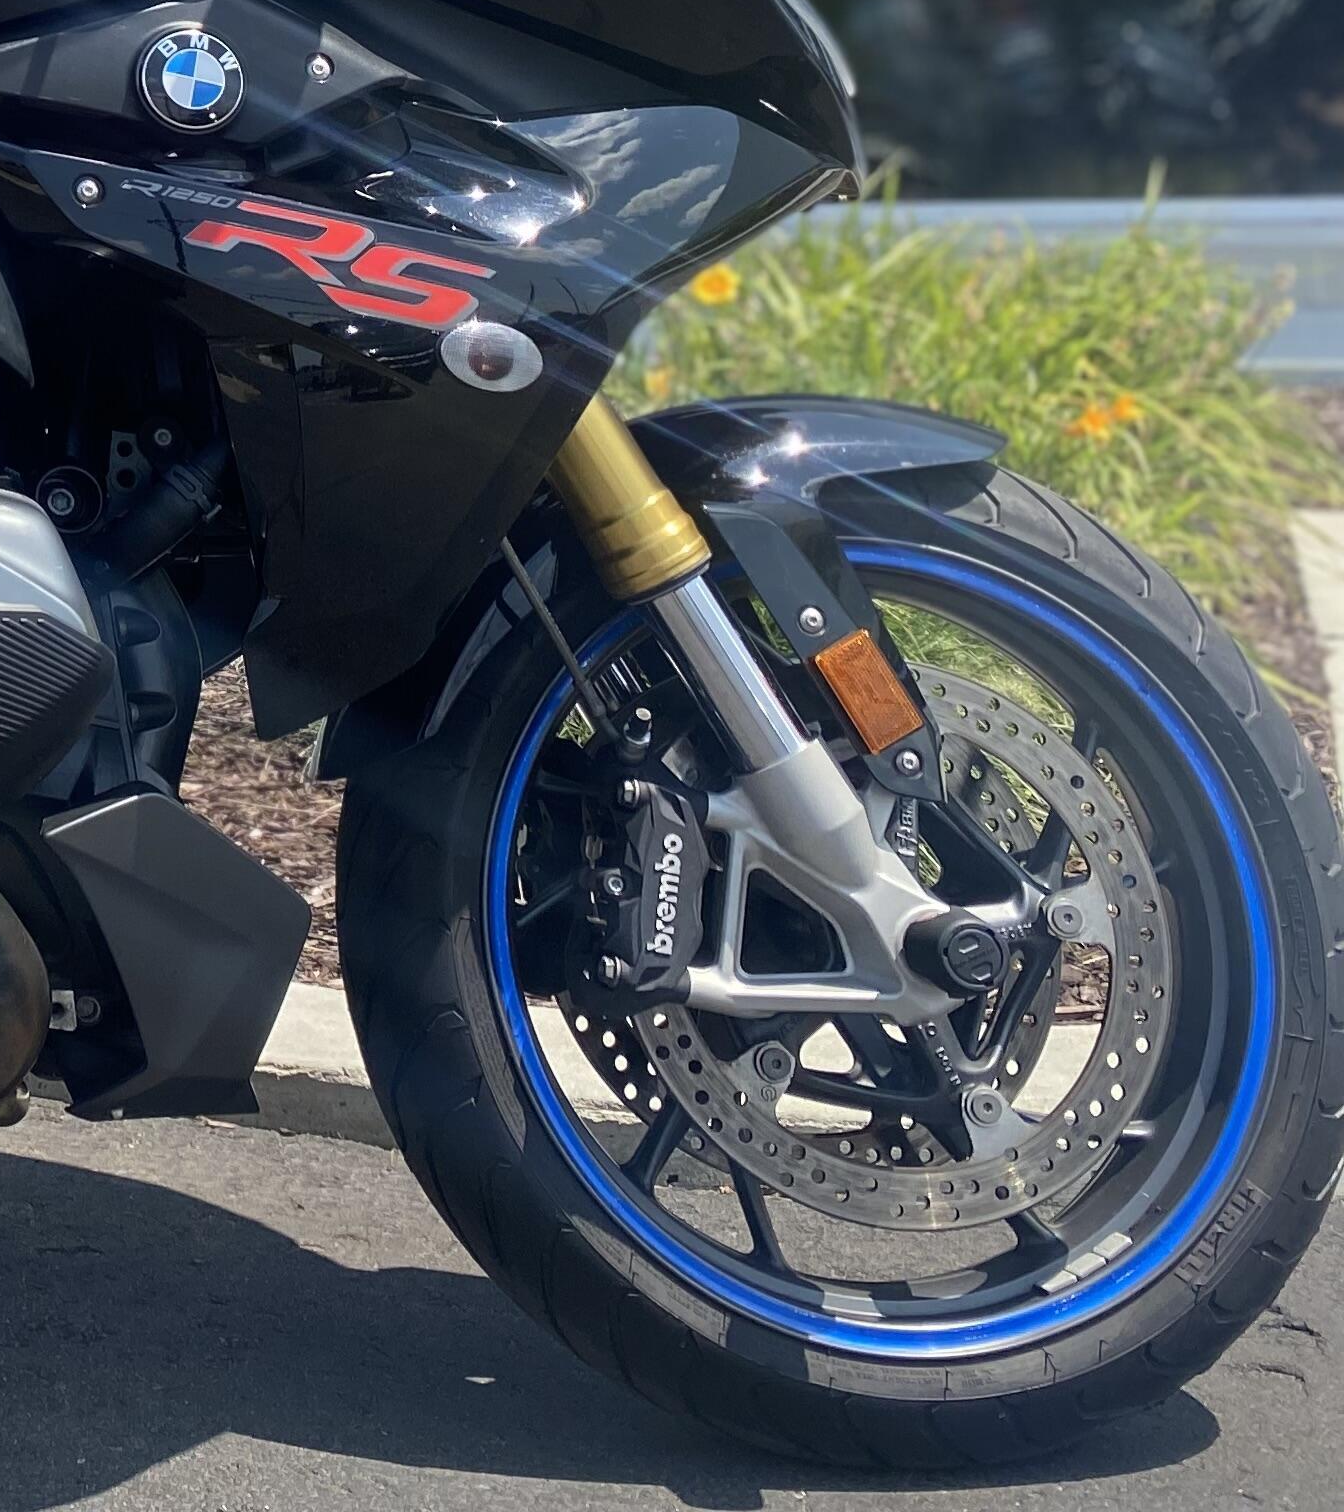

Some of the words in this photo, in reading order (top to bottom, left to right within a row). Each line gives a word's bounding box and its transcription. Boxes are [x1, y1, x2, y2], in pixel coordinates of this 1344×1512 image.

[156, 33, 239, 72] BMW
[183, 200, 496, 330] RS
[646, 833, 683, 956] brembo
